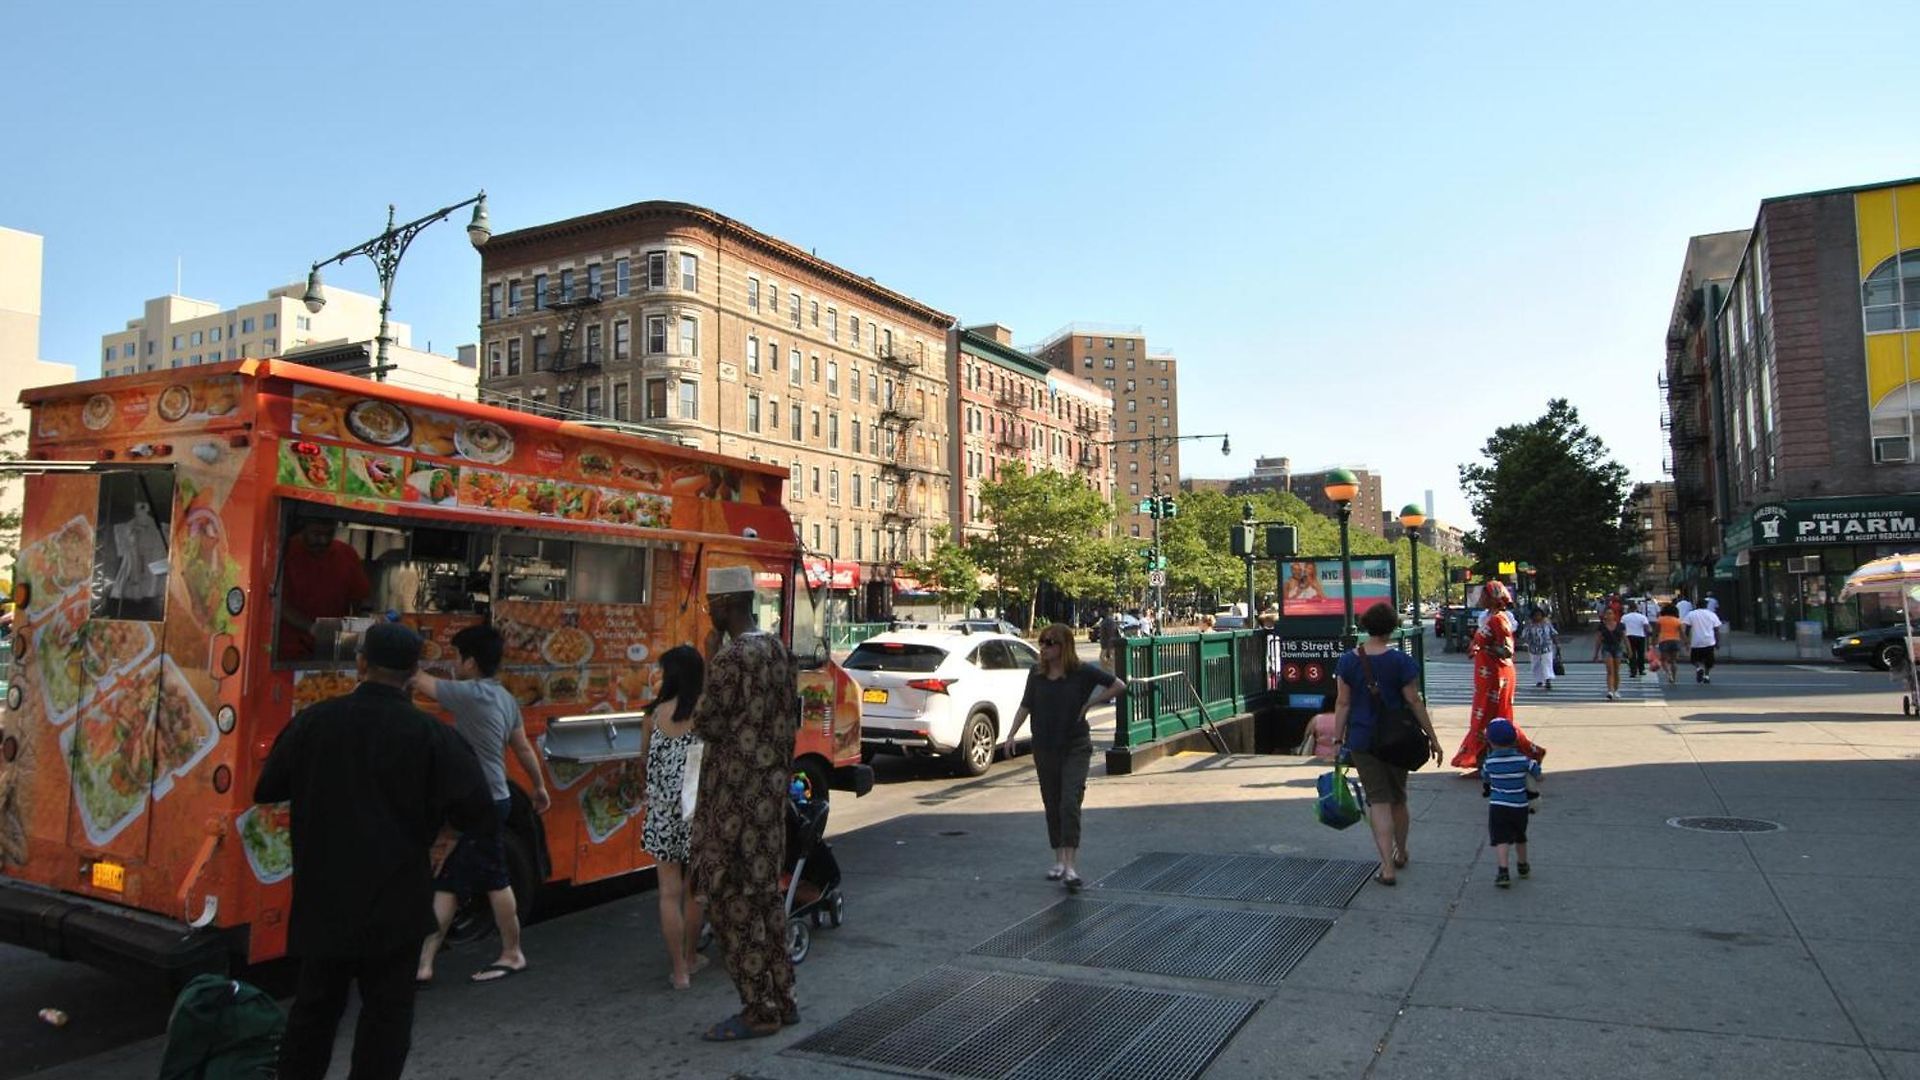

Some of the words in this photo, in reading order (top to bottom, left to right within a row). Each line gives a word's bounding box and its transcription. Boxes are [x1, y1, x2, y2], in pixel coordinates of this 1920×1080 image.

[1798, 517, 1920, 535] PHARM
[1321, 570, 1339, 580] NYC
[1281, 641, 1297, 651] 116
[1301, 641, 1334, 652] Street
[1281, 652, 1321, 660] Downtown
[1323, 652, 1330, 660] &
[1288, 666, 1297, 679] 2
[1310, 666, 1318, 679] 3
